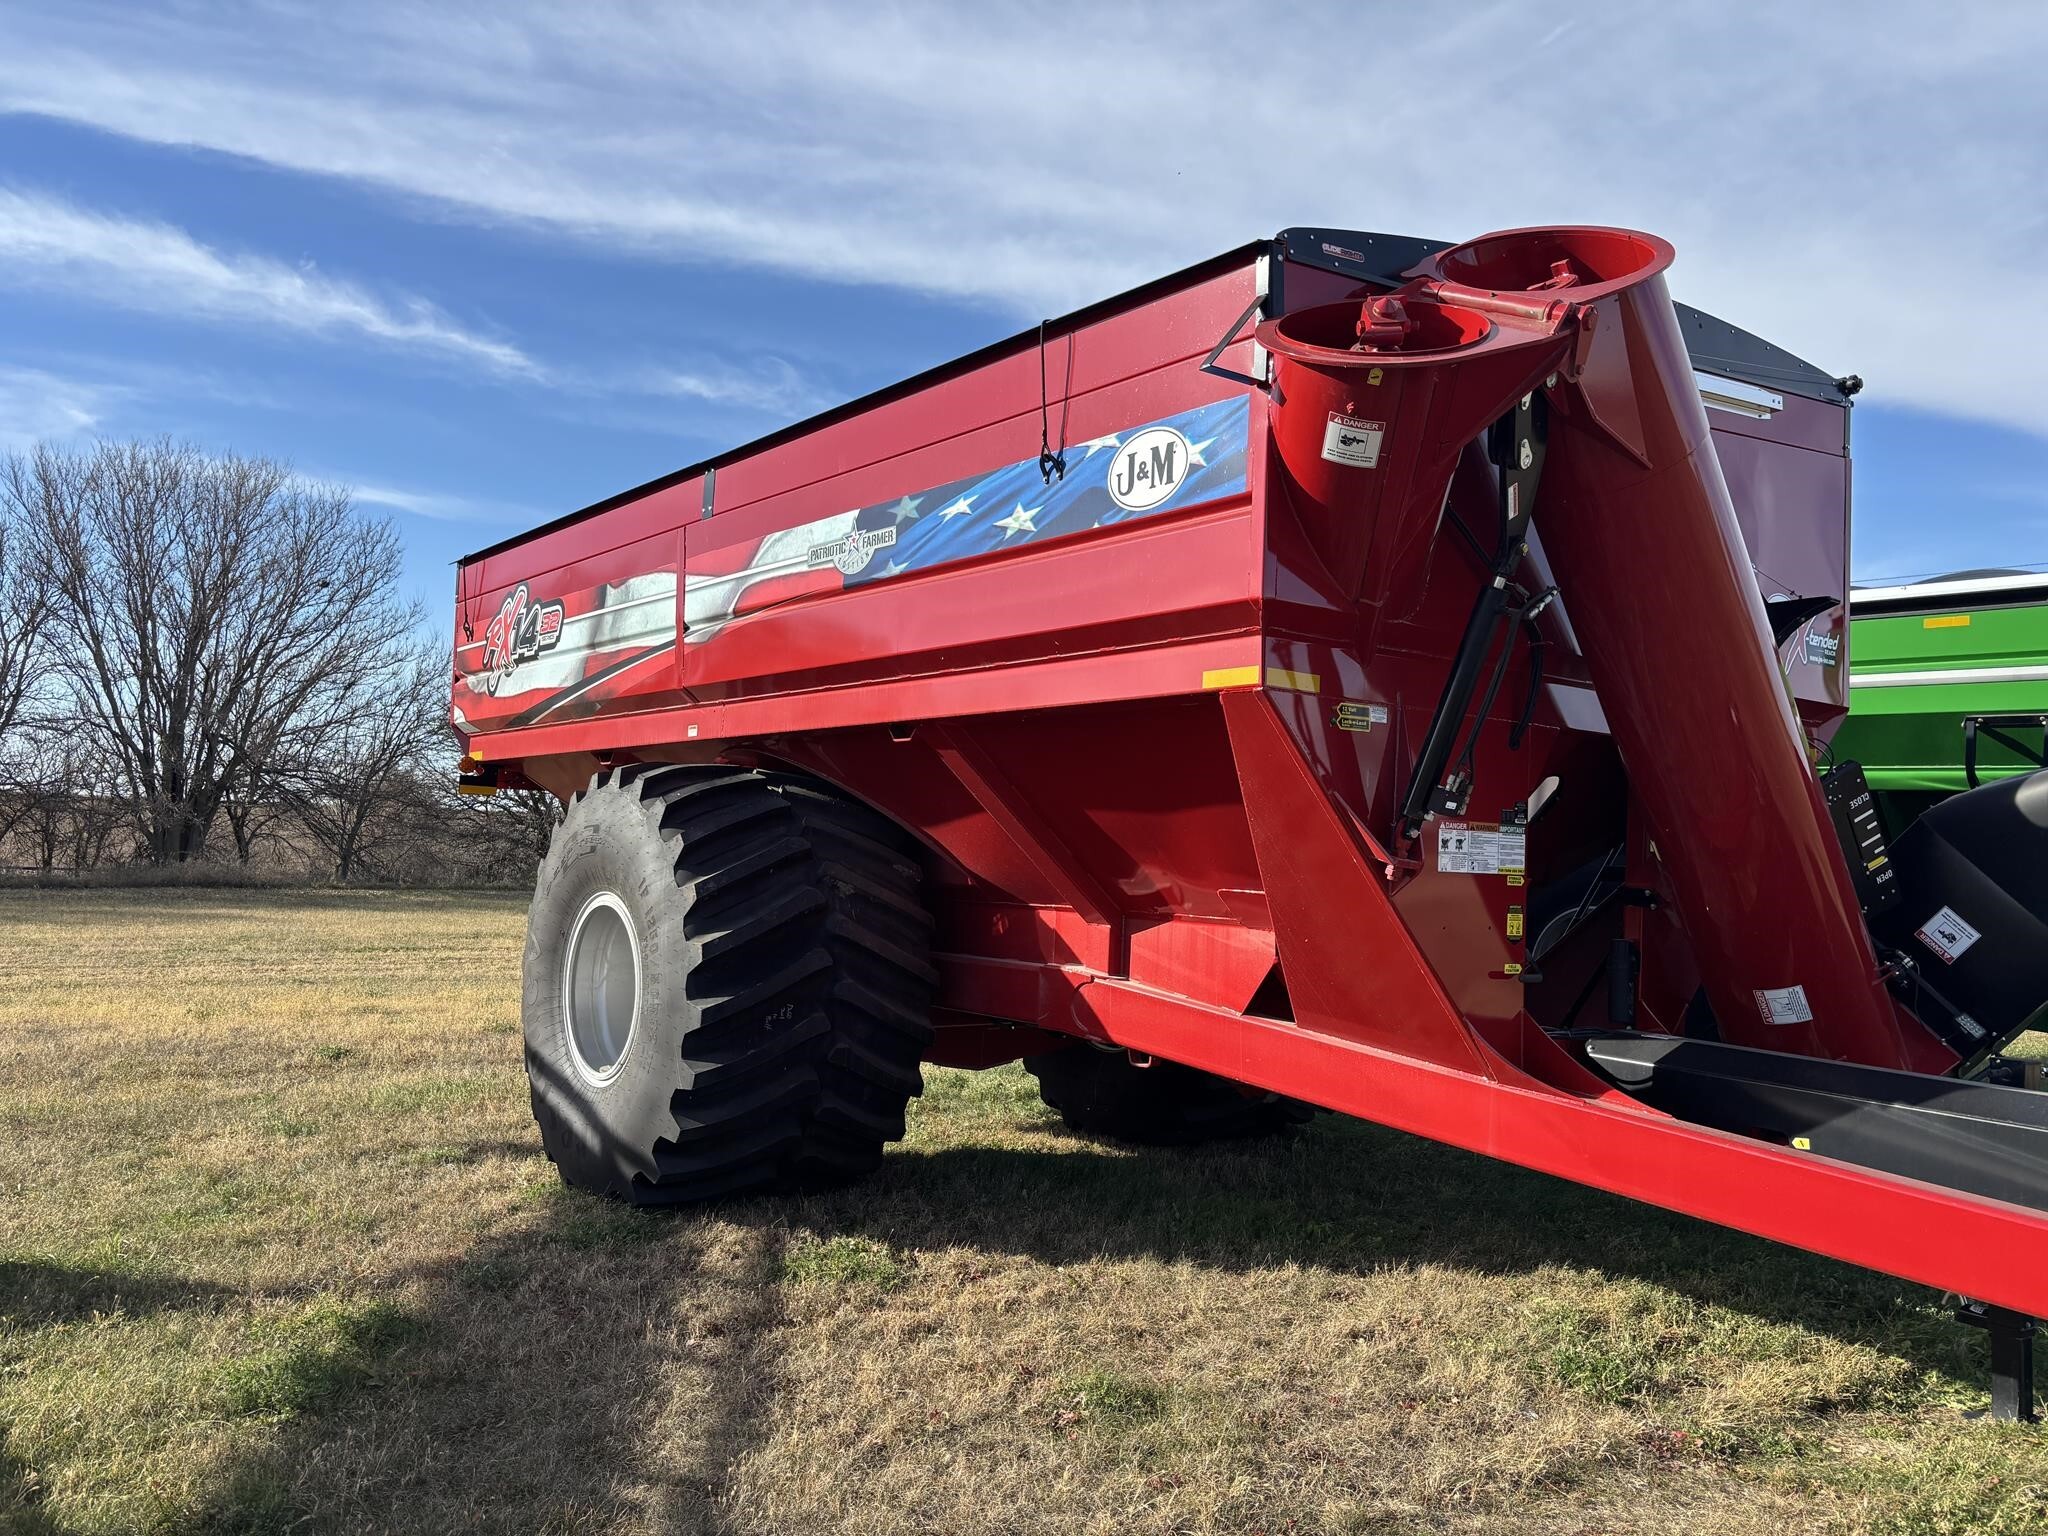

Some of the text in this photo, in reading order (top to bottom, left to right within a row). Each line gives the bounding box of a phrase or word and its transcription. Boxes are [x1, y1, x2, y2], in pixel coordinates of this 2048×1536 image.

[1343, 418, 1379, 430] DANGER
[1116, 440, 1176, 497] J&M
[810, 529, 894, 561] PATRIOTIC FARMER
[1849, 792, 1870, 810] CLOSE
[1445, 821, 1468, 830] DANGER
[1500, 825, 1526, 834] IMPORTANT
[1876, 869, 1893, 885] OPEN
[1919, 932, 1946, 955] DANGER
[1755, 990, 1771, 1018] DANGER
